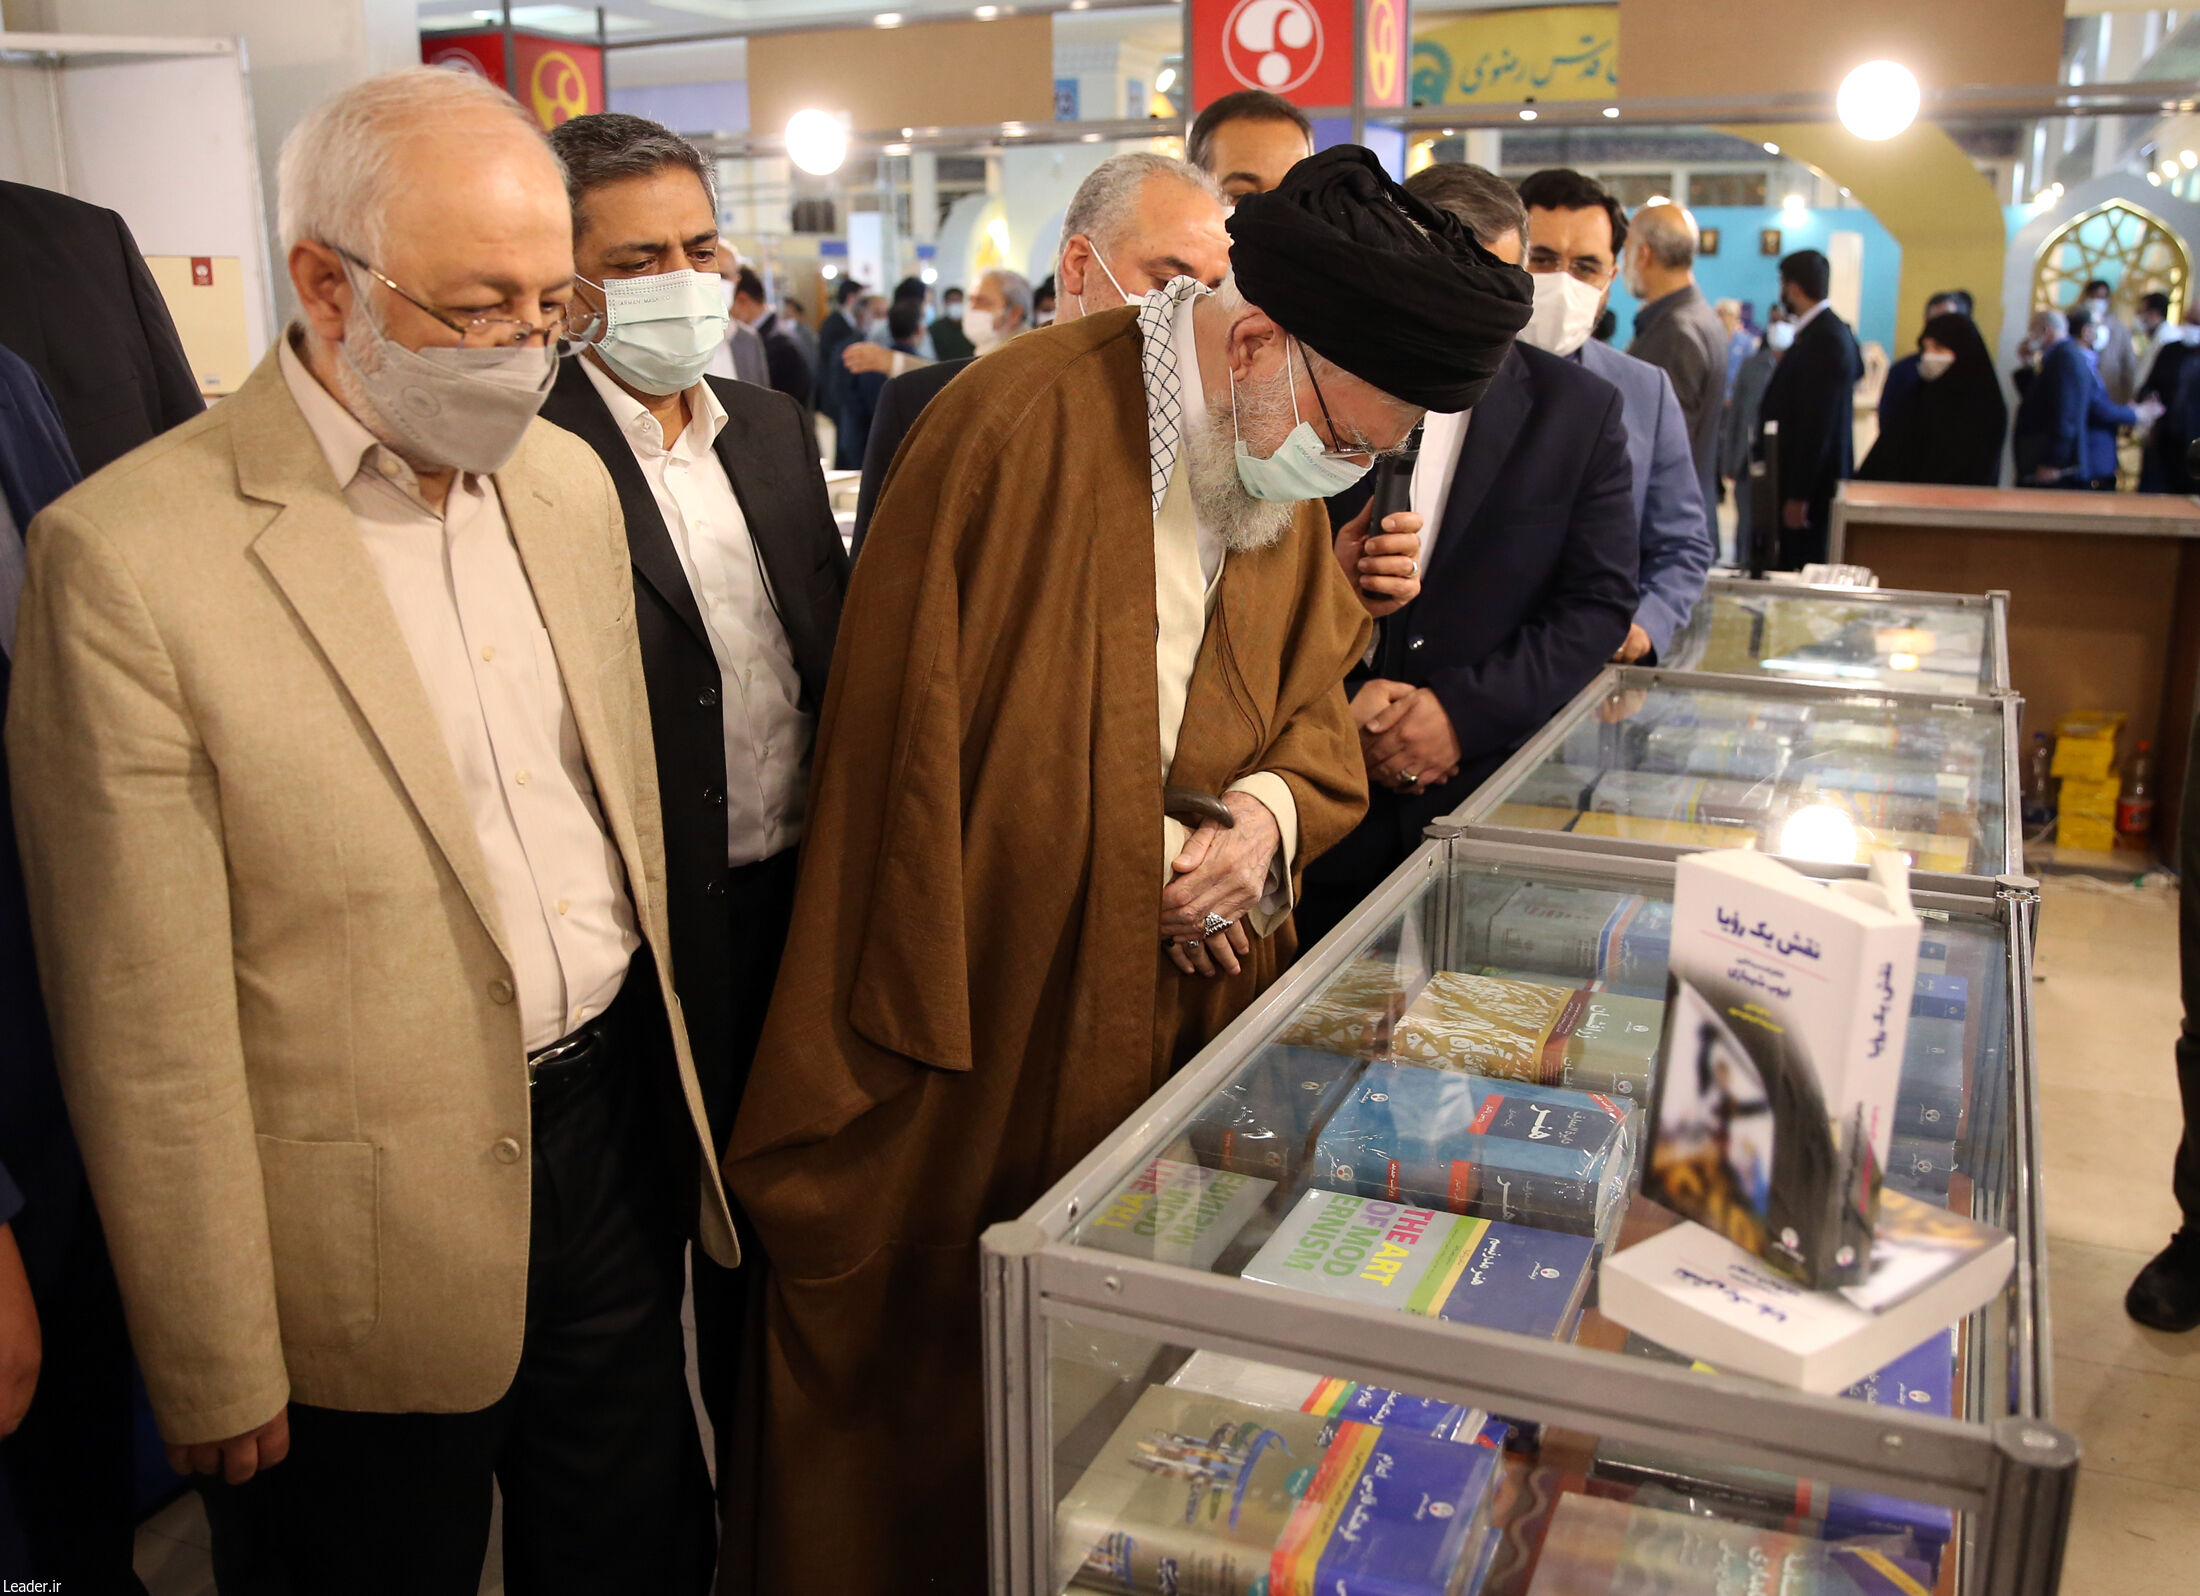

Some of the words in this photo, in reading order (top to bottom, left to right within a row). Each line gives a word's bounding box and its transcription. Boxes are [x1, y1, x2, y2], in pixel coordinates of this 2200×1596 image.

[1458, 49, 1525, 94] رضوی
[1529, 34, 1612, 87] قدس
[1749, 921, 1774, 949] یک
[1776, 931, 1821, 960] نقش
[1876, 961, 1894, 1001] نقش
[1872, 1003, 1891, 1027] یک
[1528, 1103, 1553, 1140] هنر
[1360, 1201, 1397, 1229] OF
[1496, 1175, 1516, 1220] هنر
[1282, 1194, 1364, 1271] ERNISM
[1385, 1208, 1436, 1246] THE
[1322, 1224, 1381, 1277] MOD
[1359, 1241, 1411, 1288] ART
[1470, 1267, 1487, 1286] هنر
[1479, 1237, 1502, 1270] مدرنیسم
[1338, 1503, 1371, 1542] فرهنگ
